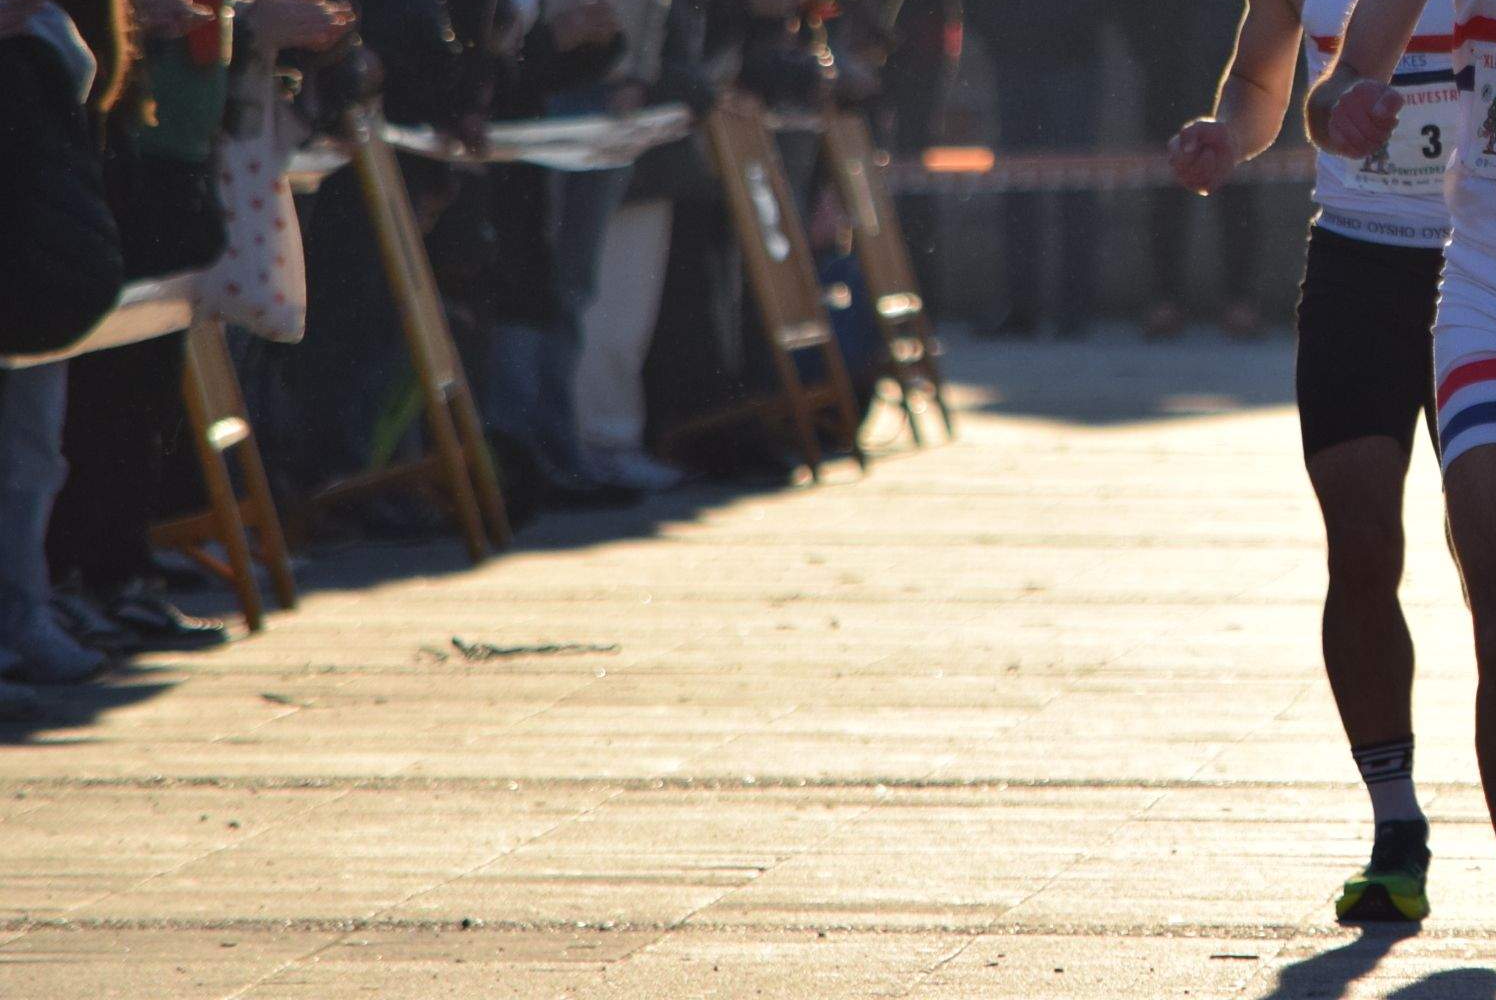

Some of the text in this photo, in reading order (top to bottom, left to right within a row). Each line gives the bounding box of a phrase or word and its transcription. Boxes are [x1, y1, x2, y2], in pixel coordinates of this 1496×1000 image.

[1402, 55, 1428, 67] KES
[1404, 89, 1460, 104] ILVESTR
[1420, 124, 1442, 159] 3
[1367, 221, 1416, 238] OYSHO
[1422, 226, 1451, 239] OYS
